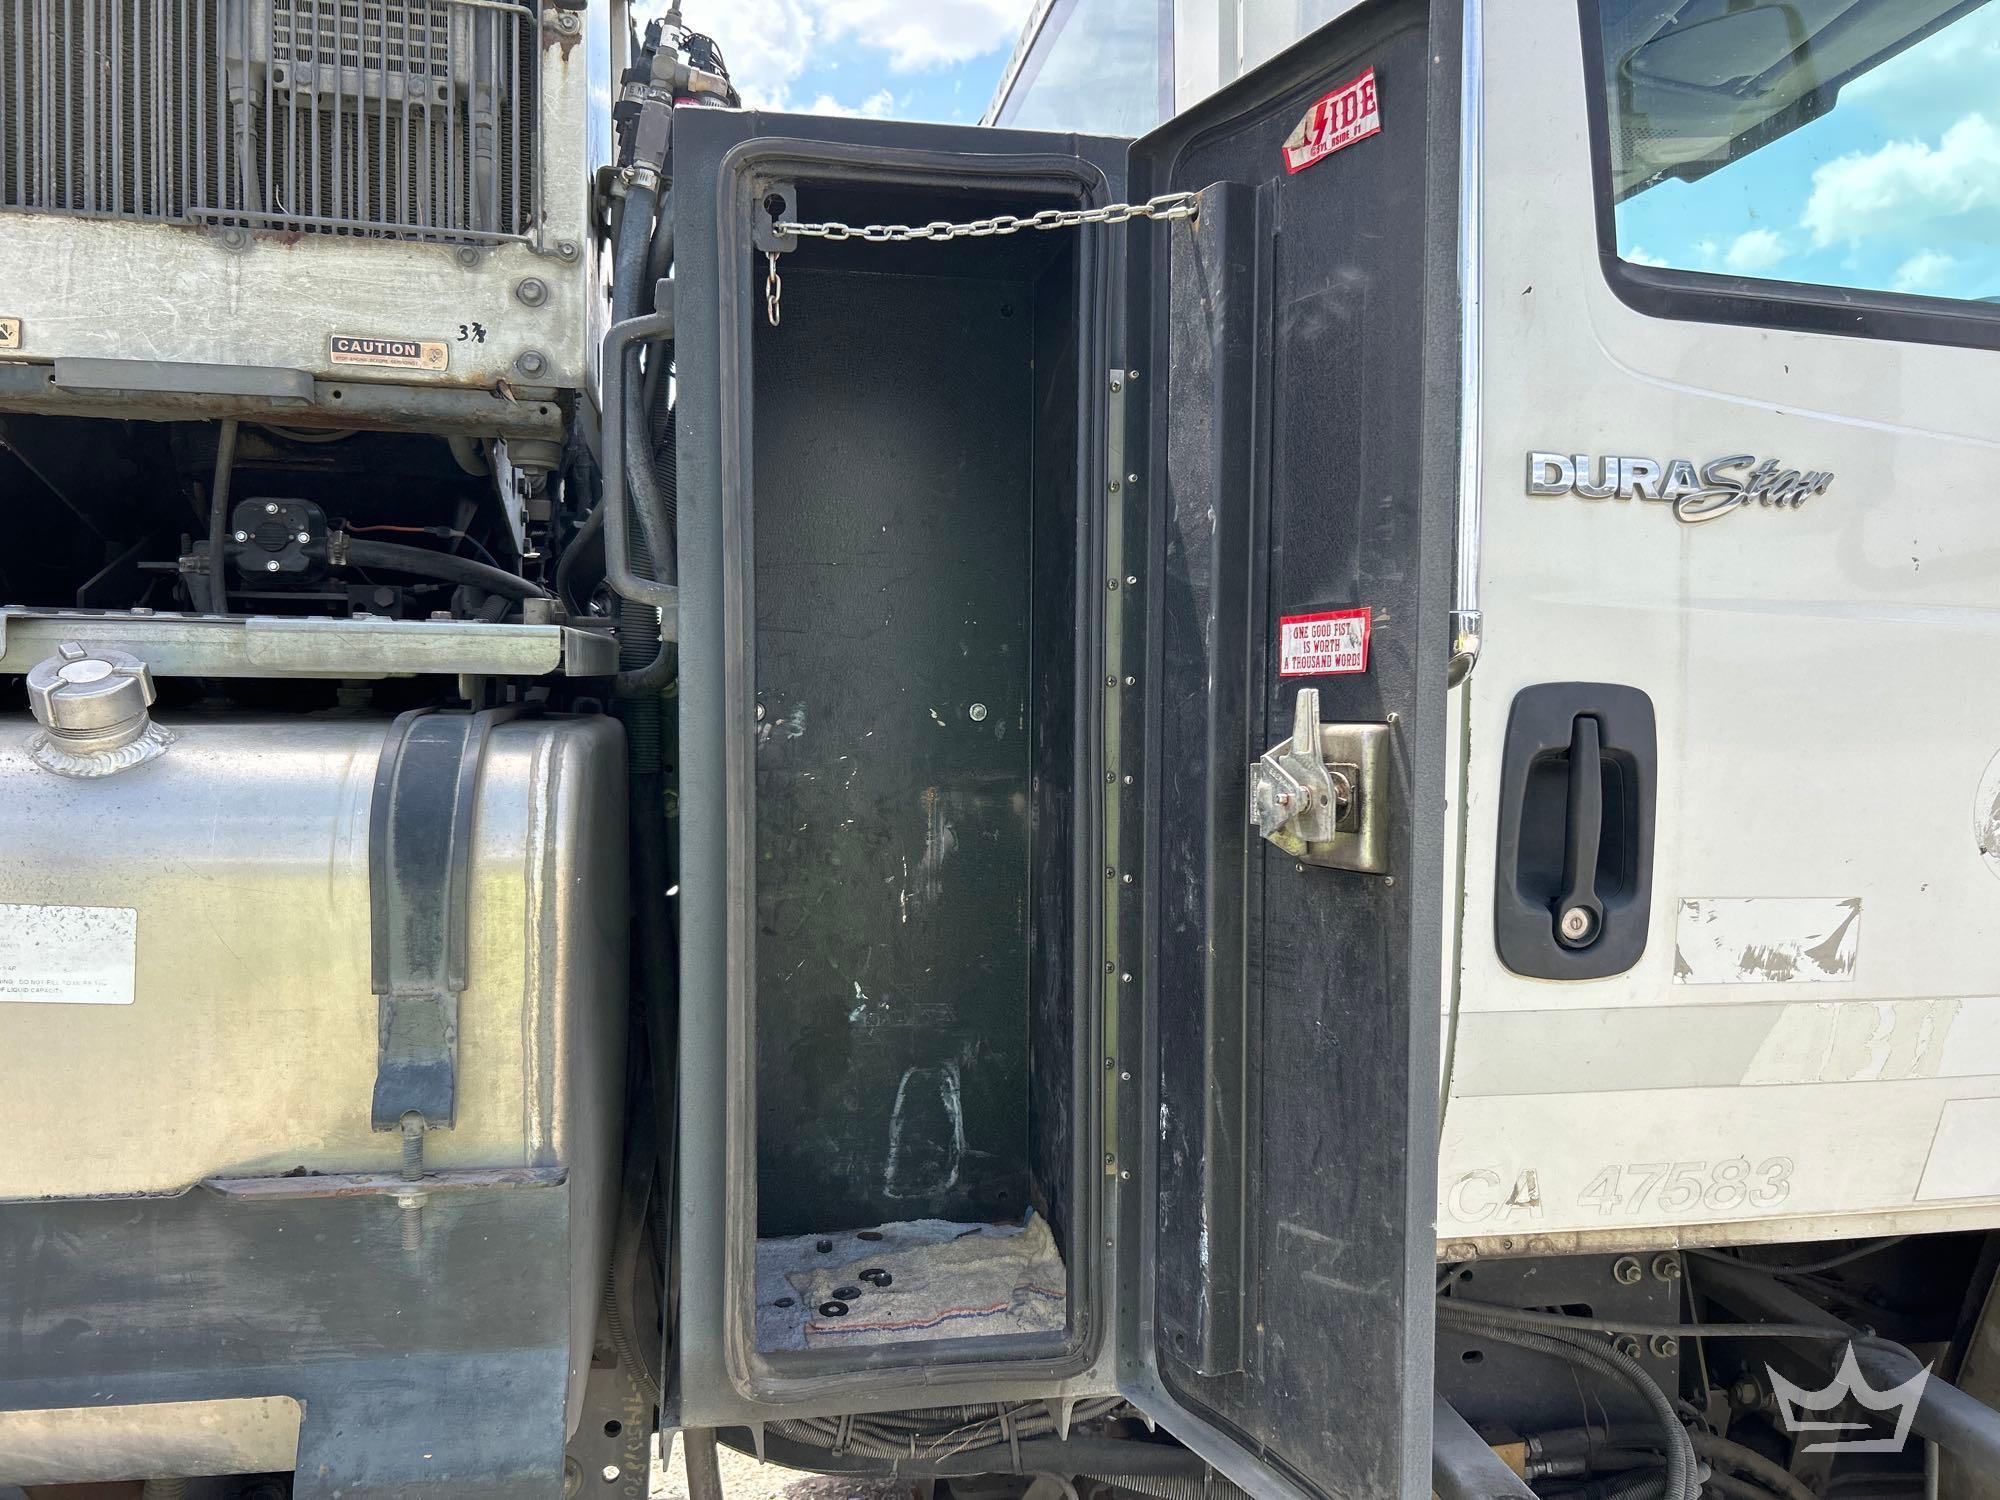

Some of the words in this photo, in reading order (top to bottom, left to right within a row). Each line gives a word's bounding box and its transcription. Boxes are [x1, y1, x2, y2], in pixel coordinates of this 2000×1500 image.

[457, 324, 469, 341] 3
[338, 339, 416, 356] CAUTION
[1293, 626, 1309, 639] ONE
[1311, 624, 1332, 638] GOOD
[1334, 622, 1351, 637] FIST
[1303, 640, 1311, 654] IS
[1313, 638, 1341, 653] WORTH
[1283, 656, 1289, 670] A
[1292, 655, 1332, 669] THOUSAND
[1334, 652, 1361, 667] WORDS
[1447, 1167, 1544, 1224] CA
[1576, 1156, 1796, 1216] 47583
